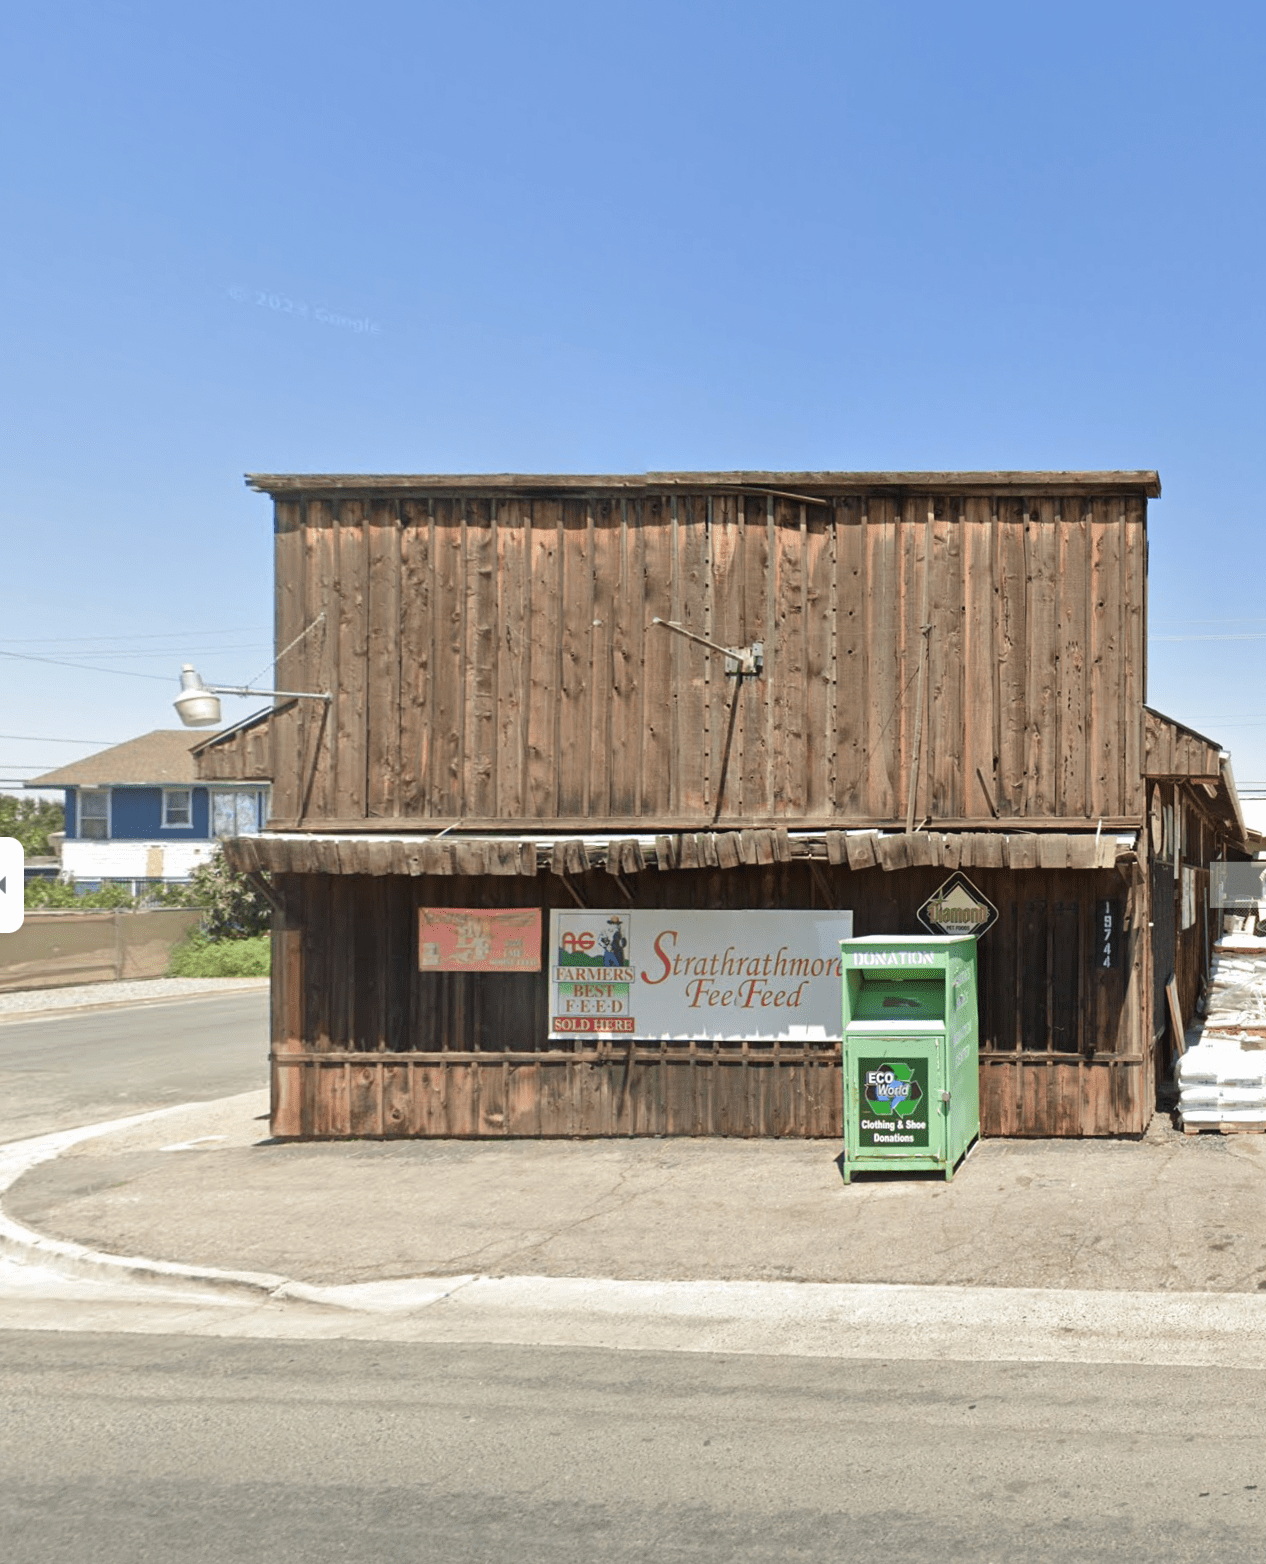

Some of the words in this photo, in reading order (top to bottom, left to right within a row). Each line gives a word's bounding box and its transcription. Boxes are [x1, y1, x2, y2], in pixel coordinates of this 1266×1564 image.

[927, 901, 989, 924] Diamond
[1103, 901, 1112, 969] 19744
[641, 930, 843, 985] Strathrathmore
[852, 951, 935, 966] DONATION
[556, 967, 634, 981] FARMERS
[573, 984, 615, 998] BEST
[554, 1017, 591, 1032] SOLD
[593, 1017, 634, 1032] HERE
[867, 1071, 894, 1084] ECO
[877, 1083, 910, 1096] World
[861, 1119, 896, 1131] Clothing
[897, 1119, 904, 1130] &
[905, 1119, 926, 1130] Shoe
[873, 1133, 915, 1143] Donations
